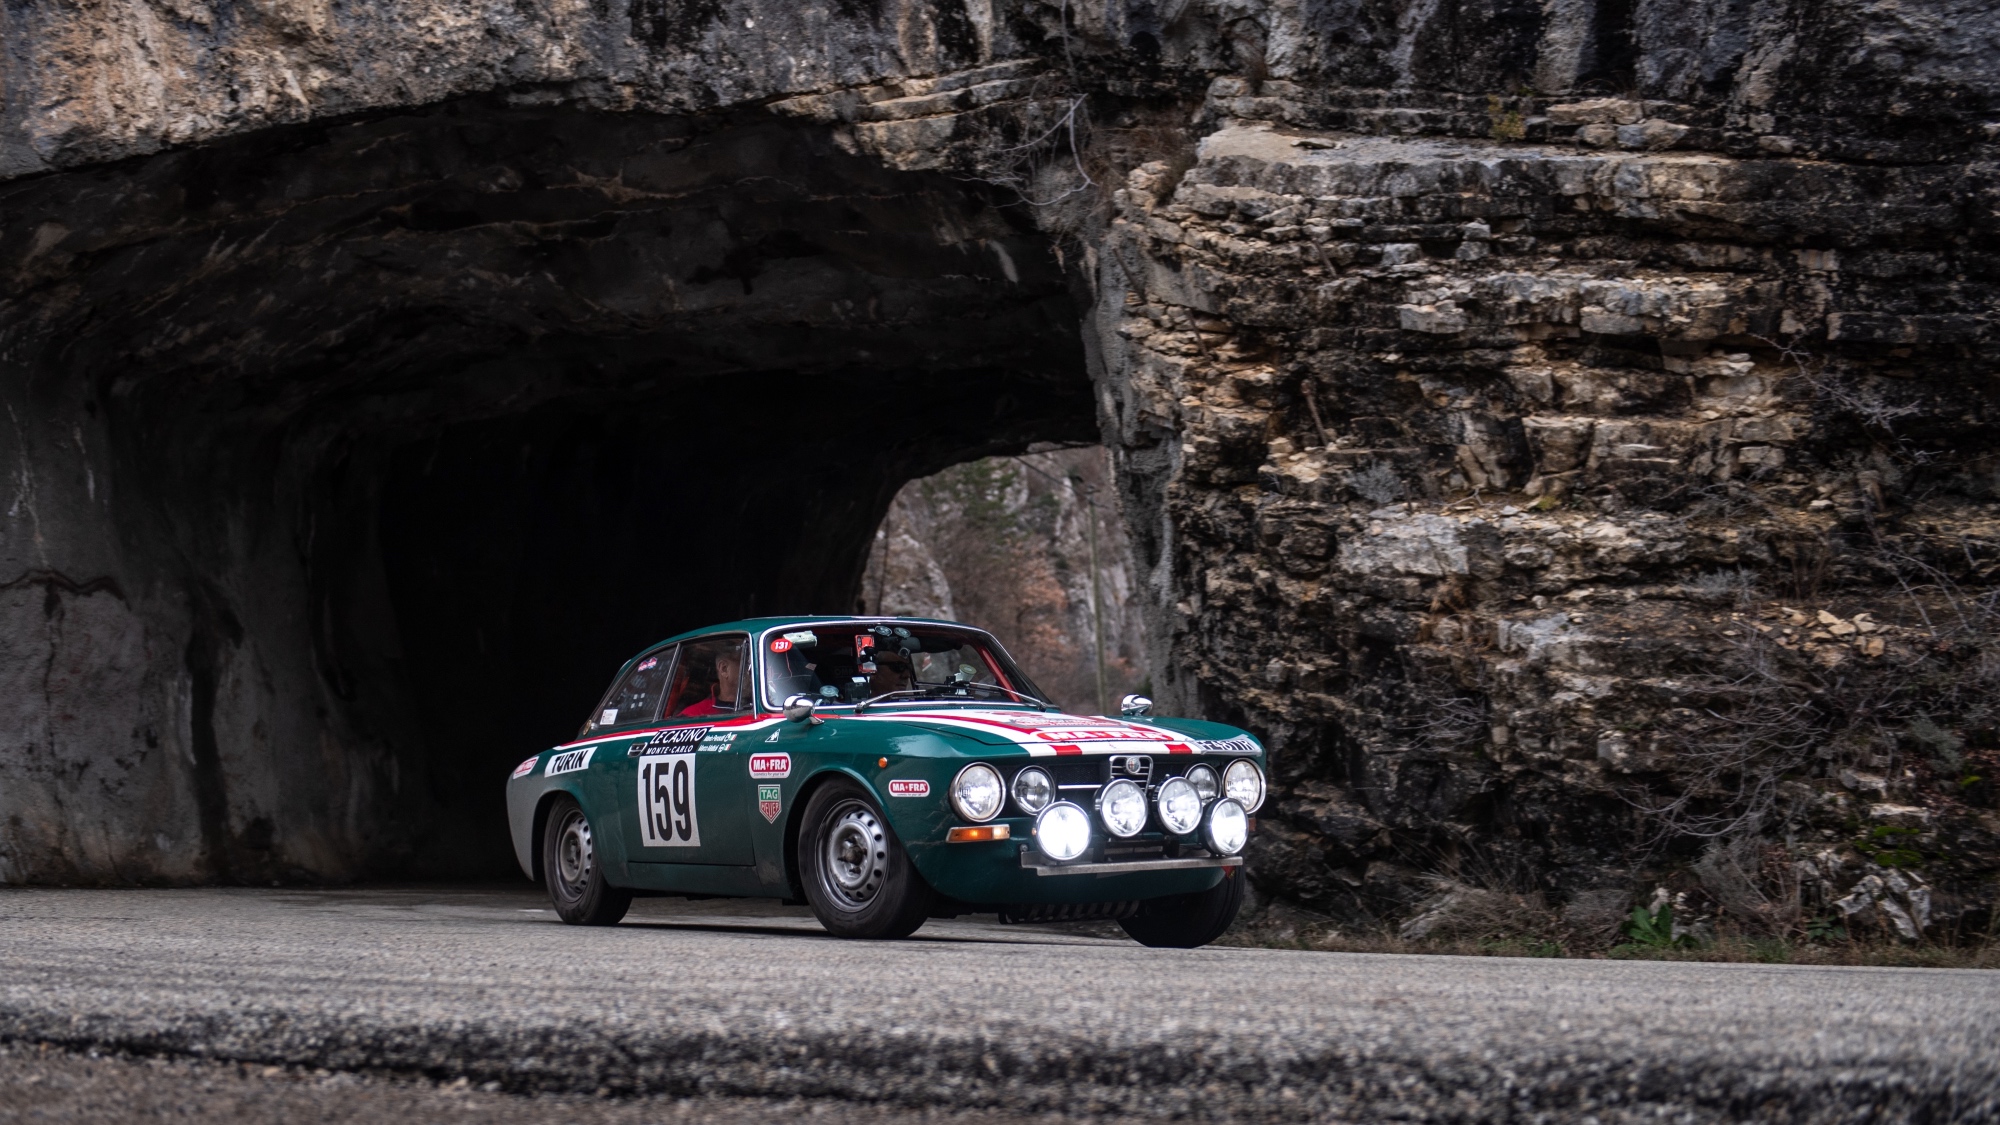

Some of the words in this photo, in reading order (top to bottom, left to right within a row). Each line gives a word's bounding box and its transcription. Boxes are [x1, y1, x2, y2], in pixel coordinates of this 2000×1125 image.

[775, 641, 788, 650] 131
[552, 750, 588, 773] TURIN
[643, 760, 692, 842] 159
[761, 789, 778, 799] TAG
[761, 803, 779, 818] HEUER
